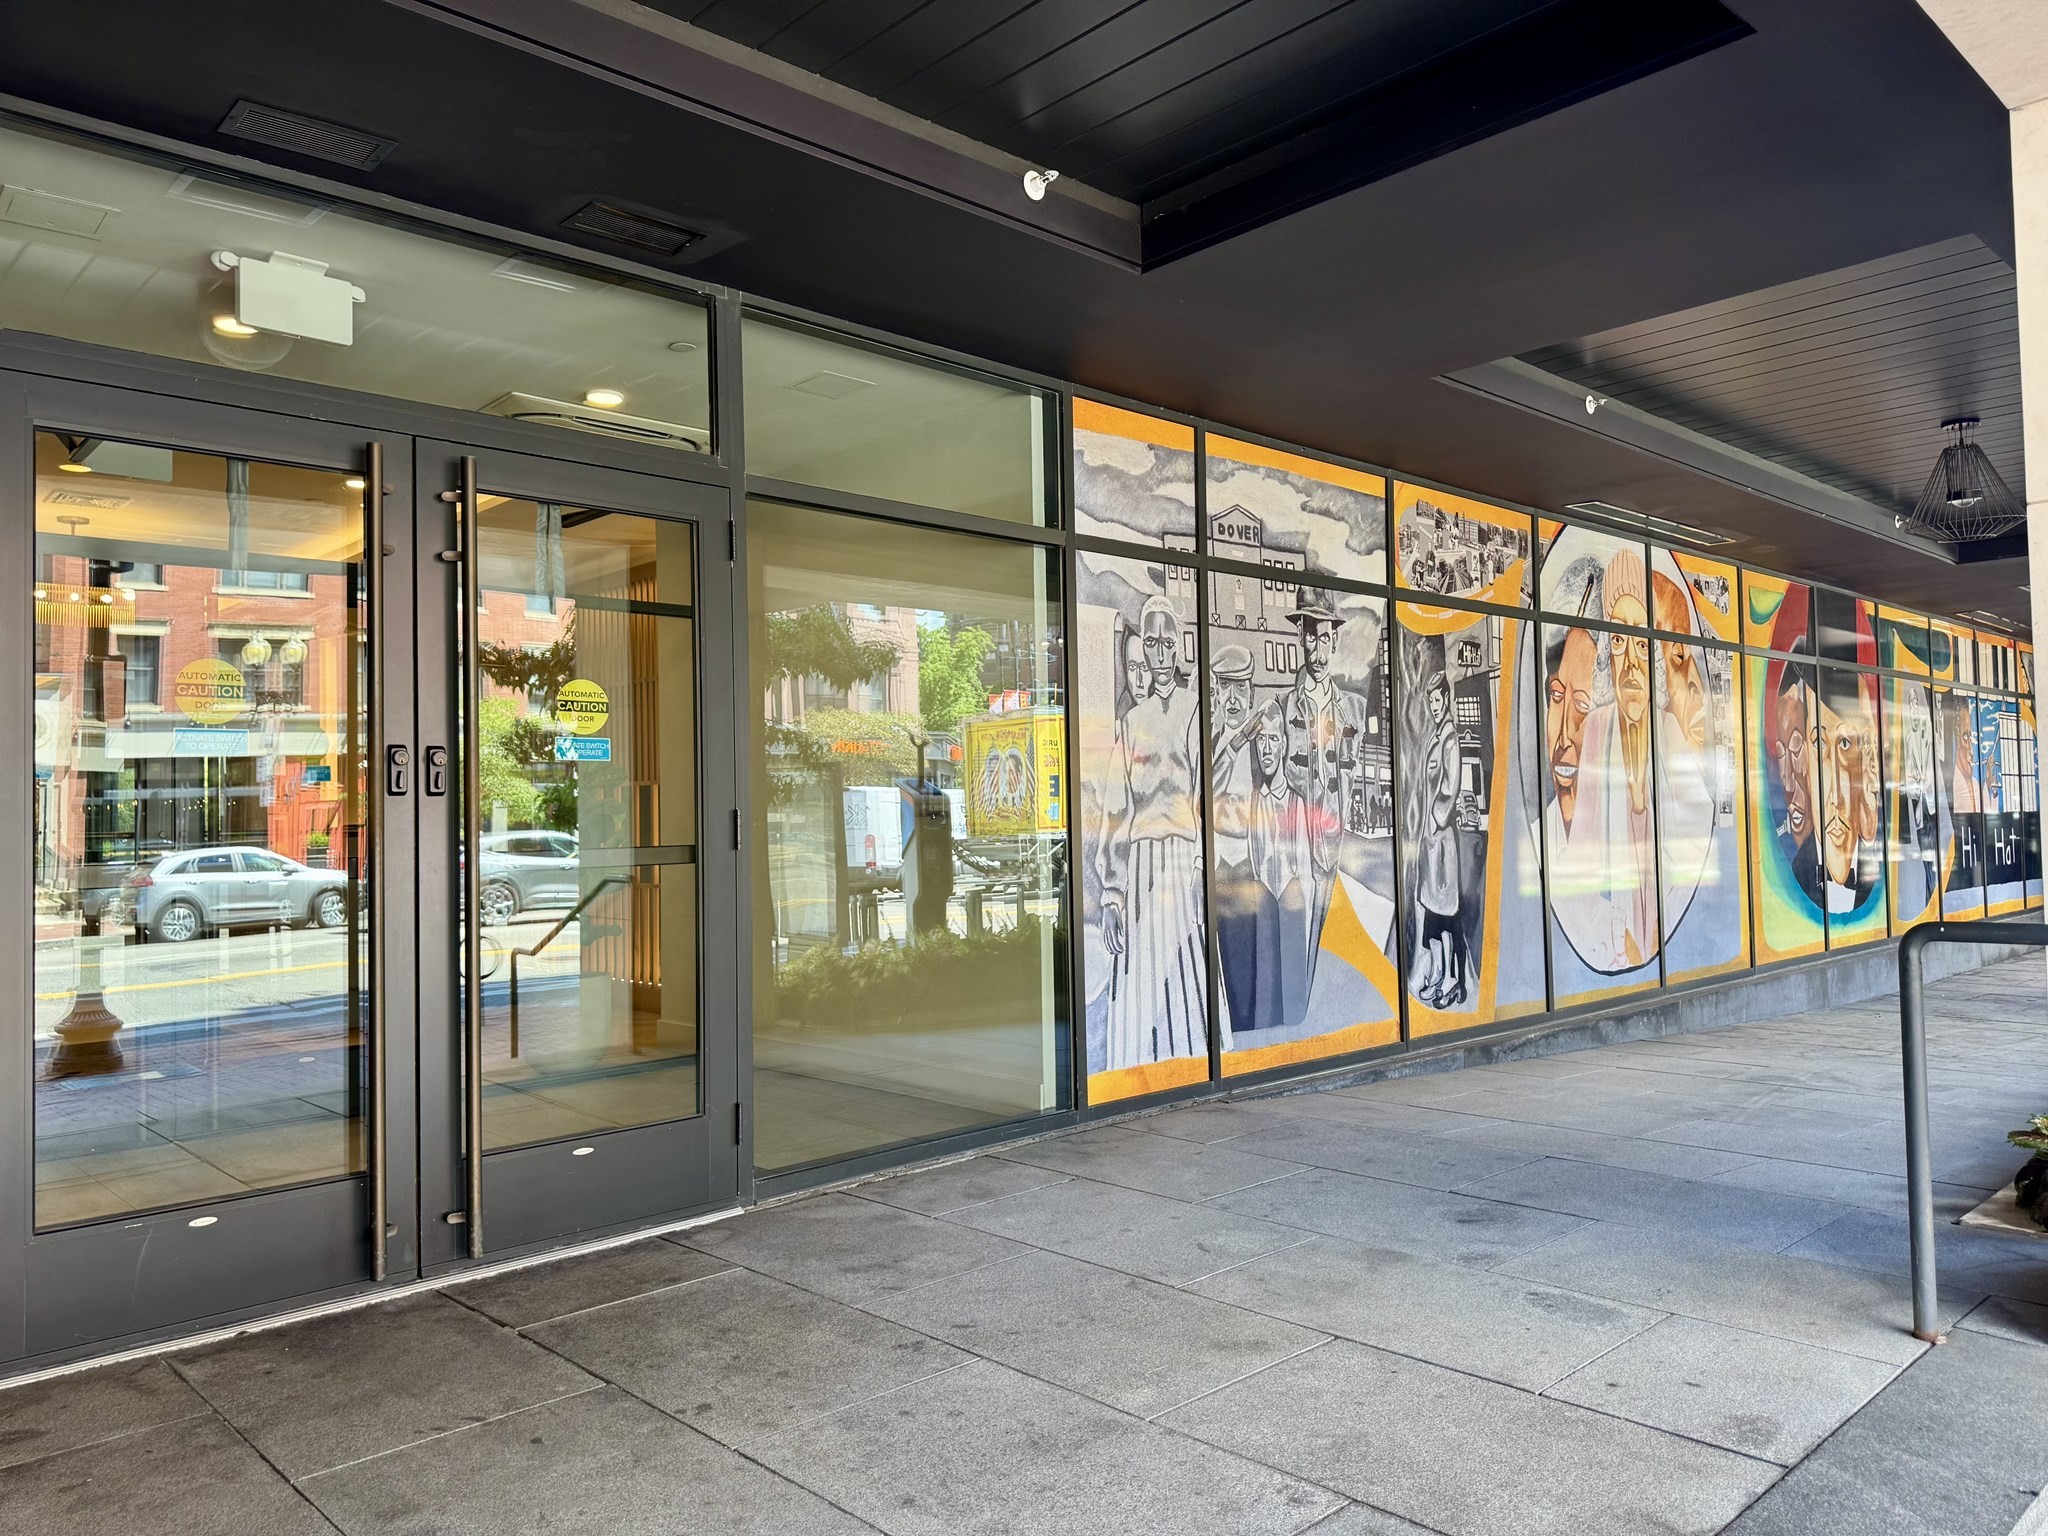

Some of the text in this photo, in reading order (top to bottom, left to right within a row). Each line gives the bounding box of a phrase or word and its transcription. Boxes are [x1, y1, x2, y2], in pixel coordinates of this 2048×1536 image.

[1218, 522, 1259, 544] DOVER
[178, 672, 241, 682] AUTOMATIC
[177, 685, 243, 697] CAUTION
[558, 701, 607, 712] CAUTION
[1962, 826, 2020, 869] Hi Hat
